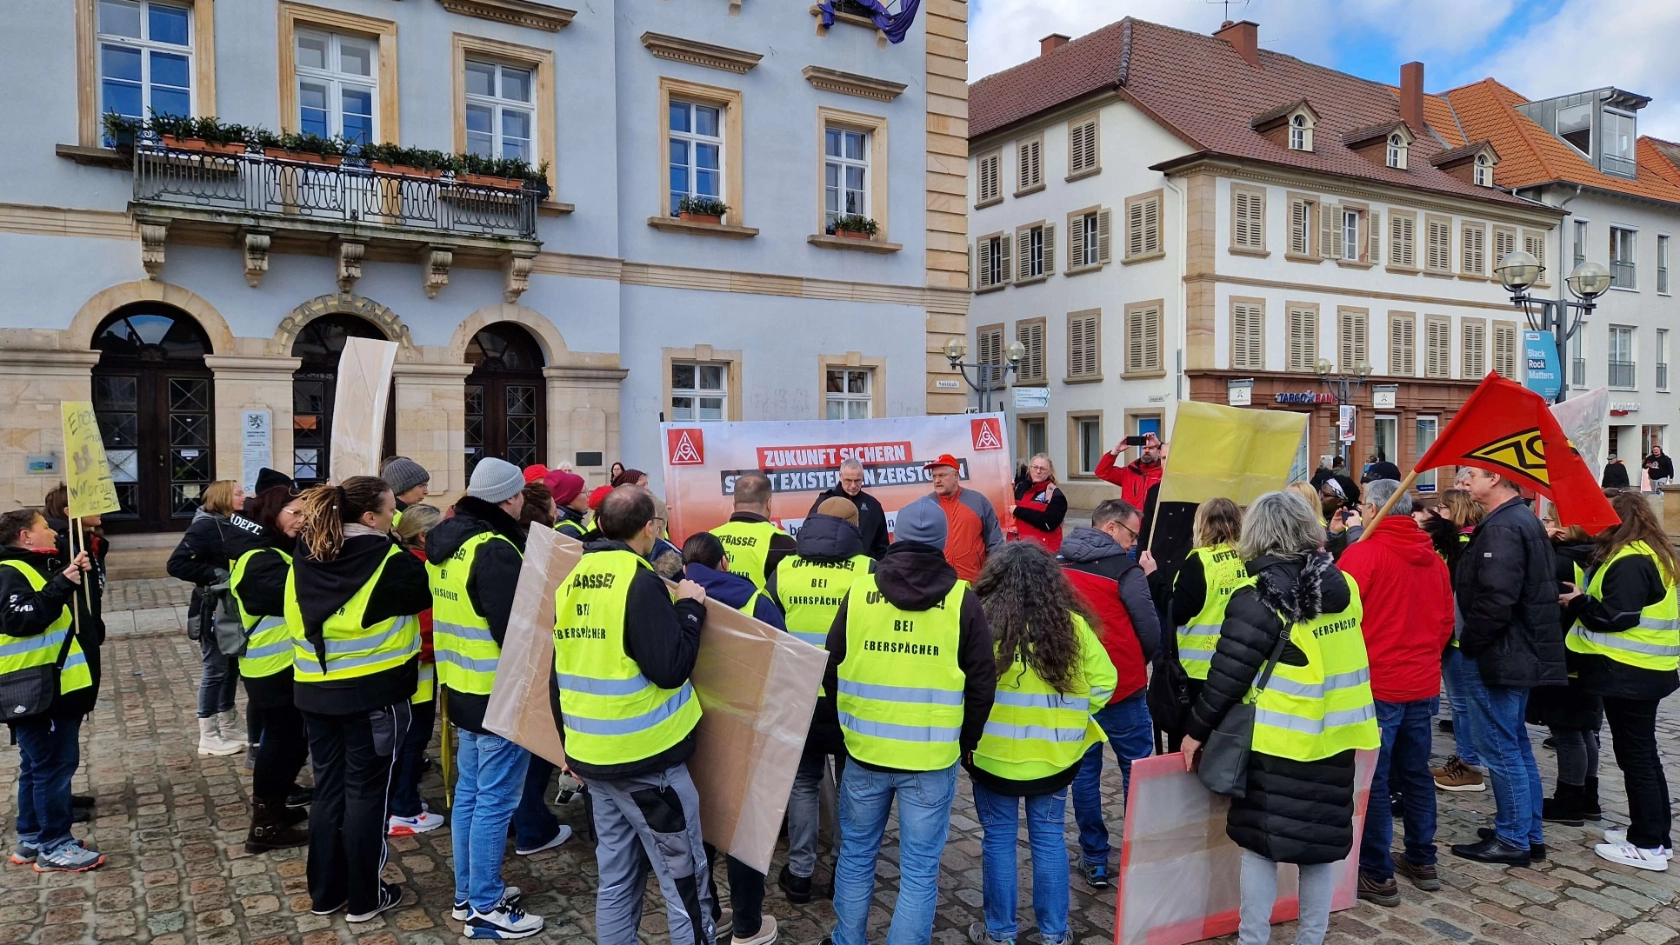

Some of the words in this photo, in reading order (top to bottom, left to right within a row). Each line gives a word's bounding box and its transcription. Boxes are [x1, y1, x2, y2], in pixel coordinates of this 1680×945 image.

[1527, 348, 1546, 358] Black
[1528, 359, 1545, 369] Rock
[1529, 370, 1554, 380] Matters
[763, 448, 837, 467] ZUKUNFT
[841, 445, 906, 463] SICHERN
[811, 578, 828, 589] BEI
[788, 595, 843, 606] EBERSPÄCHE
[893, 619, 914, 633] BEI
[863, 639, 940, 657] EBERSPÄCHER
